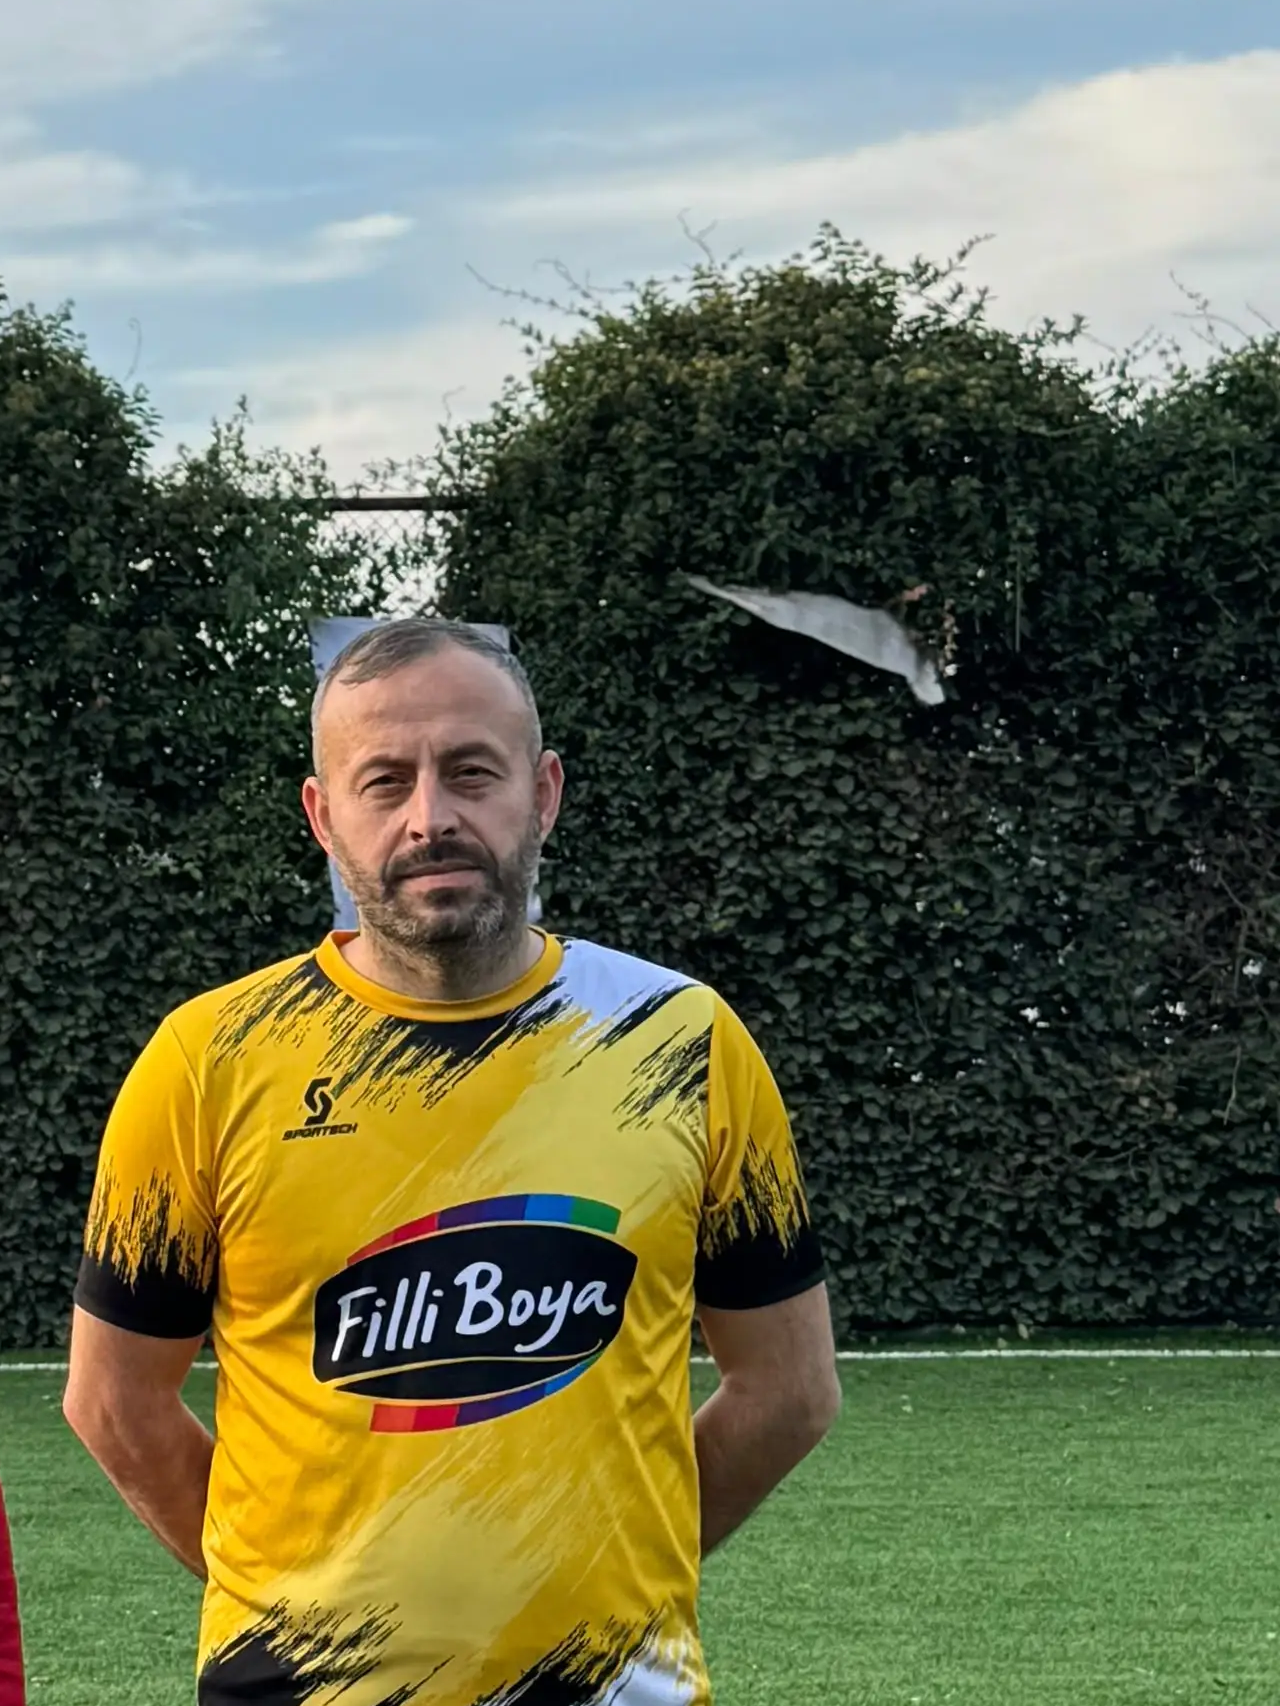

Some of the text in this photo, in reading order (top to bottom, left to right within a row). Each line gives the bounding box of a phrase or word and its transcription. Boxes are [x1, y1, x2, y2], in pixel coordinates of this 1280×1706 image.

[282, 1122, 358, 1140] SPORTECH
[331, 1261, 617, 1362] Filli Boya
